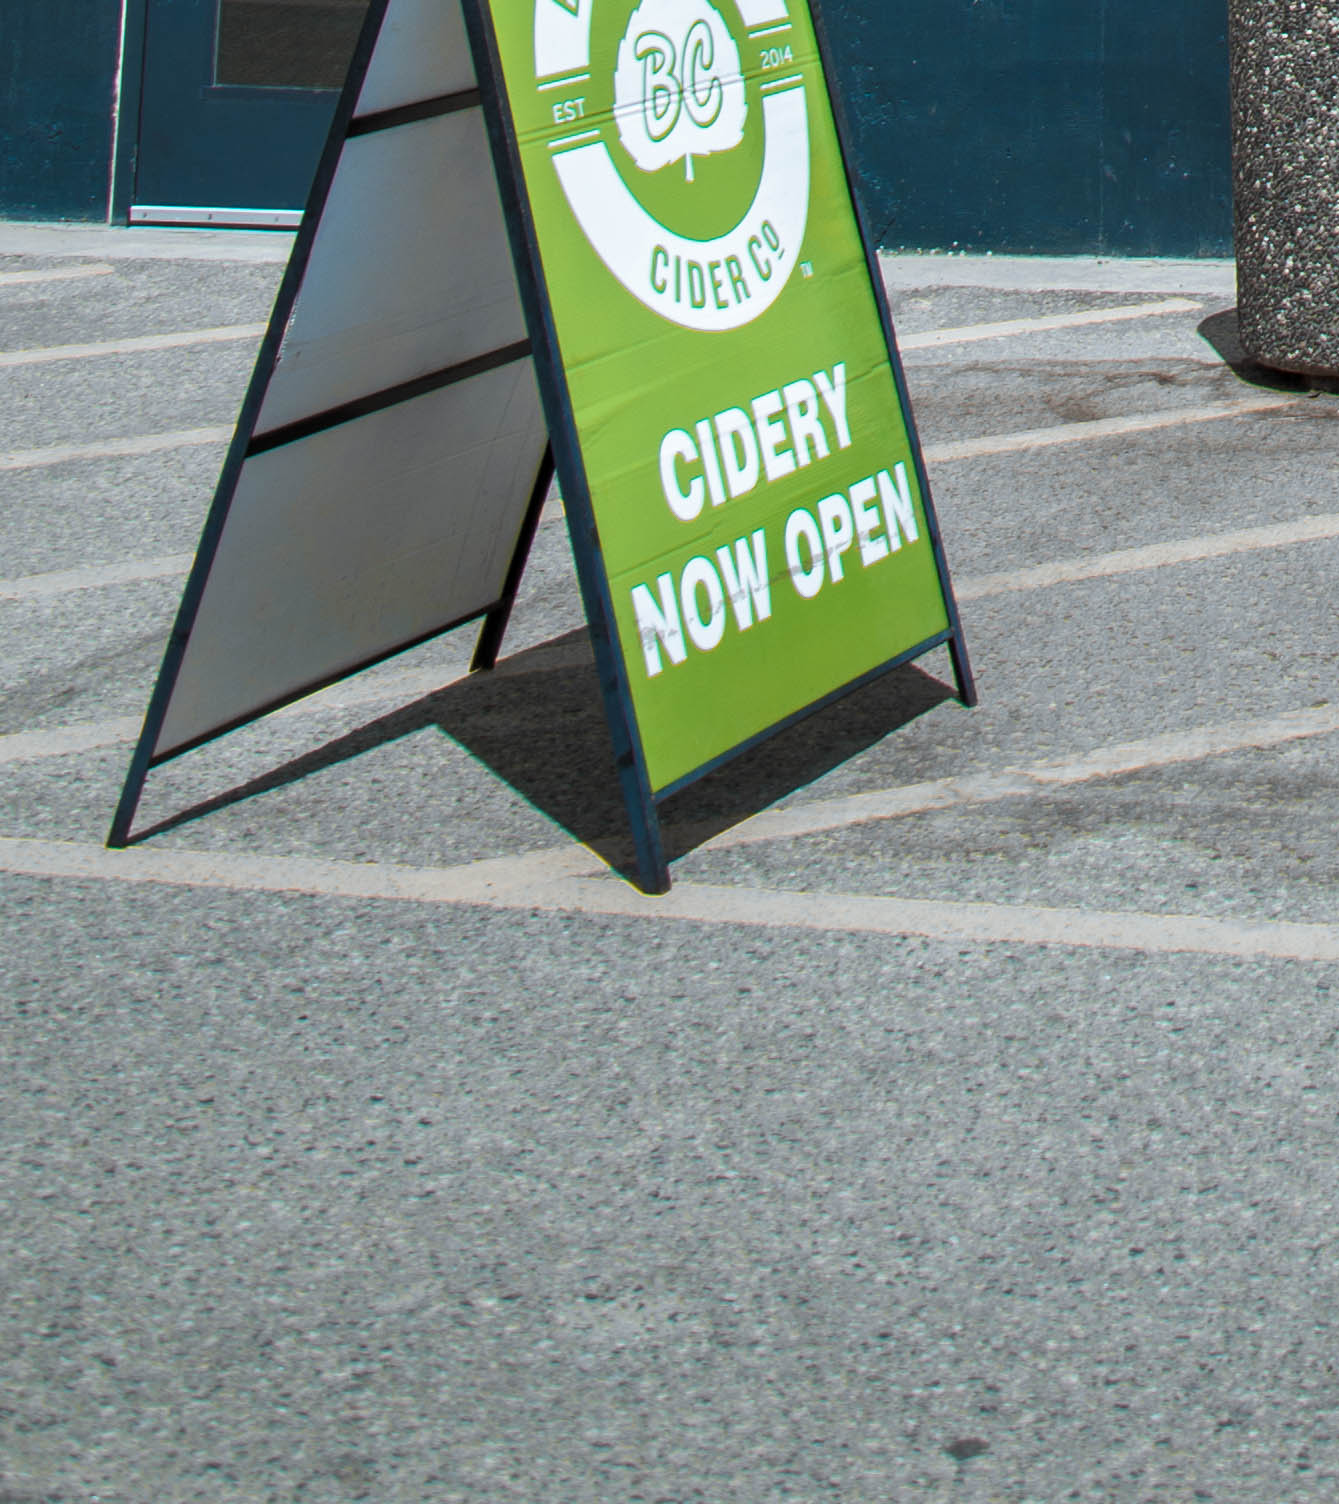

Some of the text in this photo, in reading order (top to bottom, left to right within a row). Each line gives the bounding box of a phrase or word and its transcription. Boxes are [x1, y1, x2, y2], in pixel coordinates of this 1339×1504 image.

[635, 19, 723, 143] BC
[759, 44, 793, 71] 2014
[552, 96, 586, 125] EST
[650, 244, 752, 311] CIDER
[658, 360, 853, 524] CIDERY
[630, 459, 919, 680] NOW OPEN
